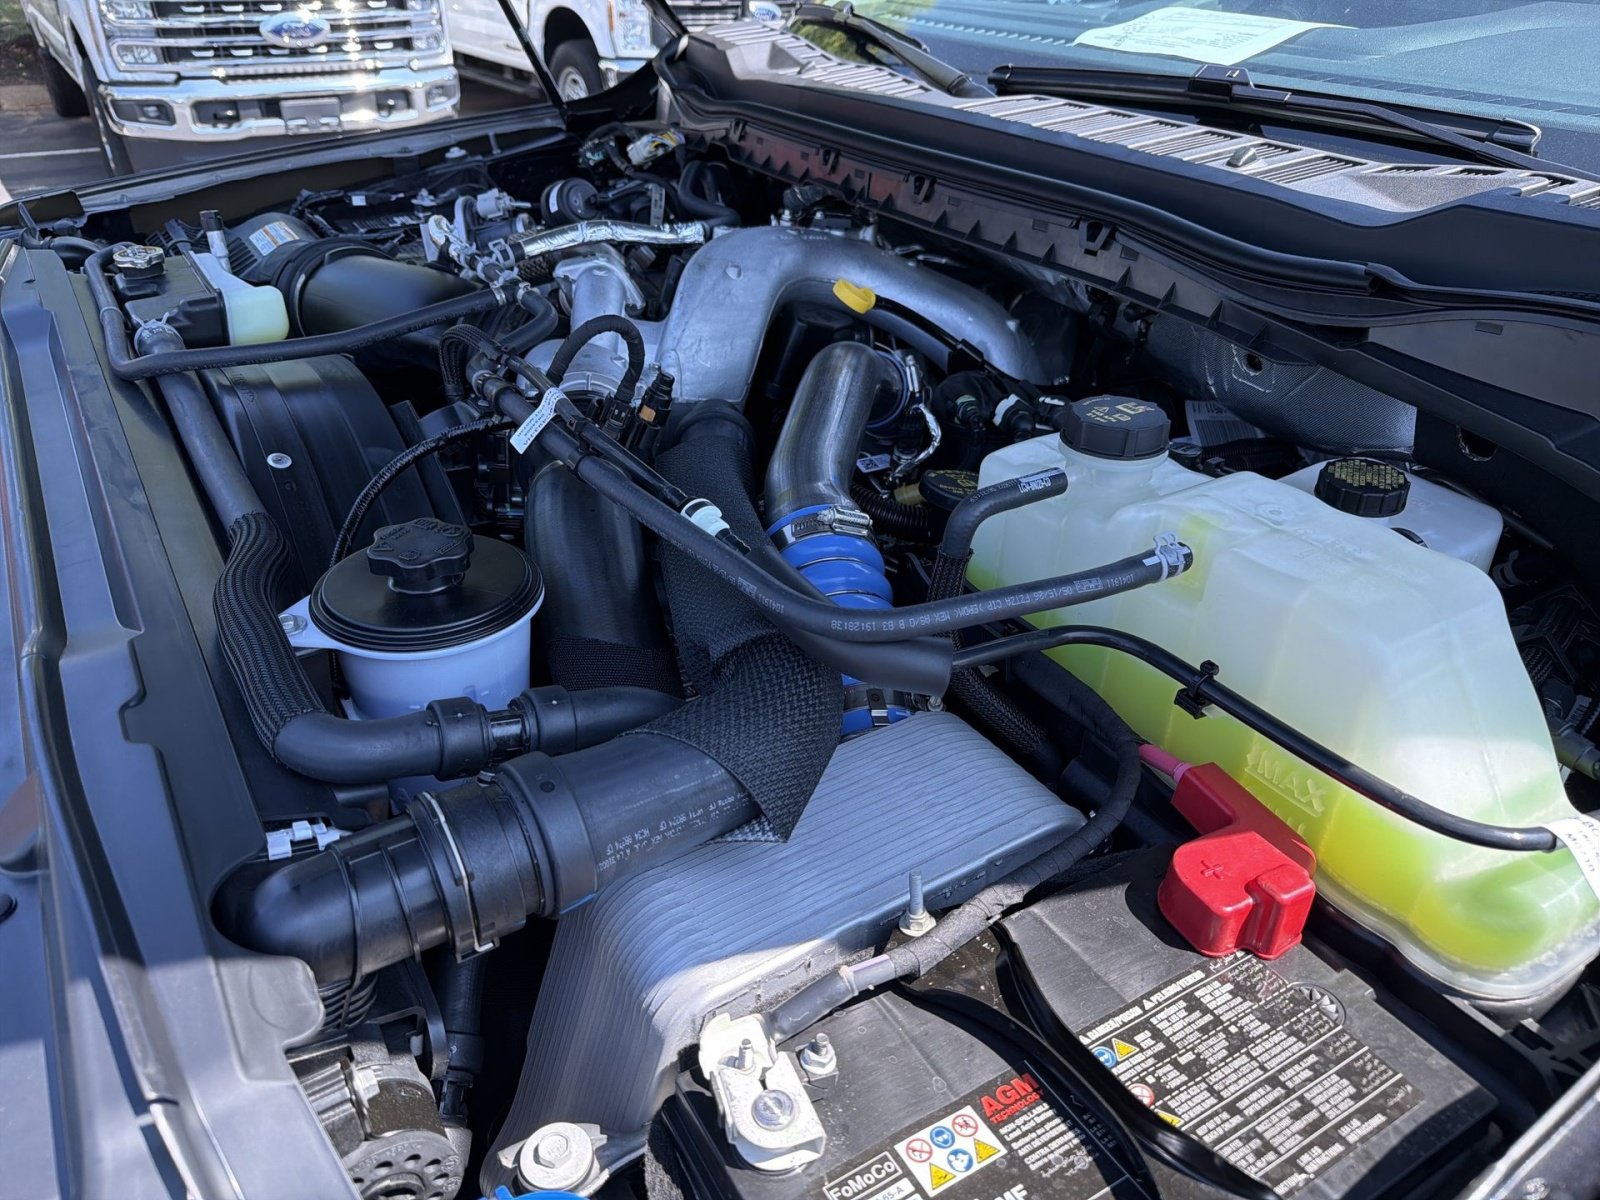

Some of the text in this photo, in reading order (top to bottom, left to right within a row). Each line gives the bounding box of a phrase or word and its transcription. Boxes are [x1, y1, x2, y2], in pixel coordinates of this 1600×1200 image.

[1257, 751, 1326, 813] MAX
[978, 1070, 1040, 1117] AGM
[989, 1089, 1045, 1125] TECHNOLOGY
[829, 1161, 896, 1200] FoMoCo
